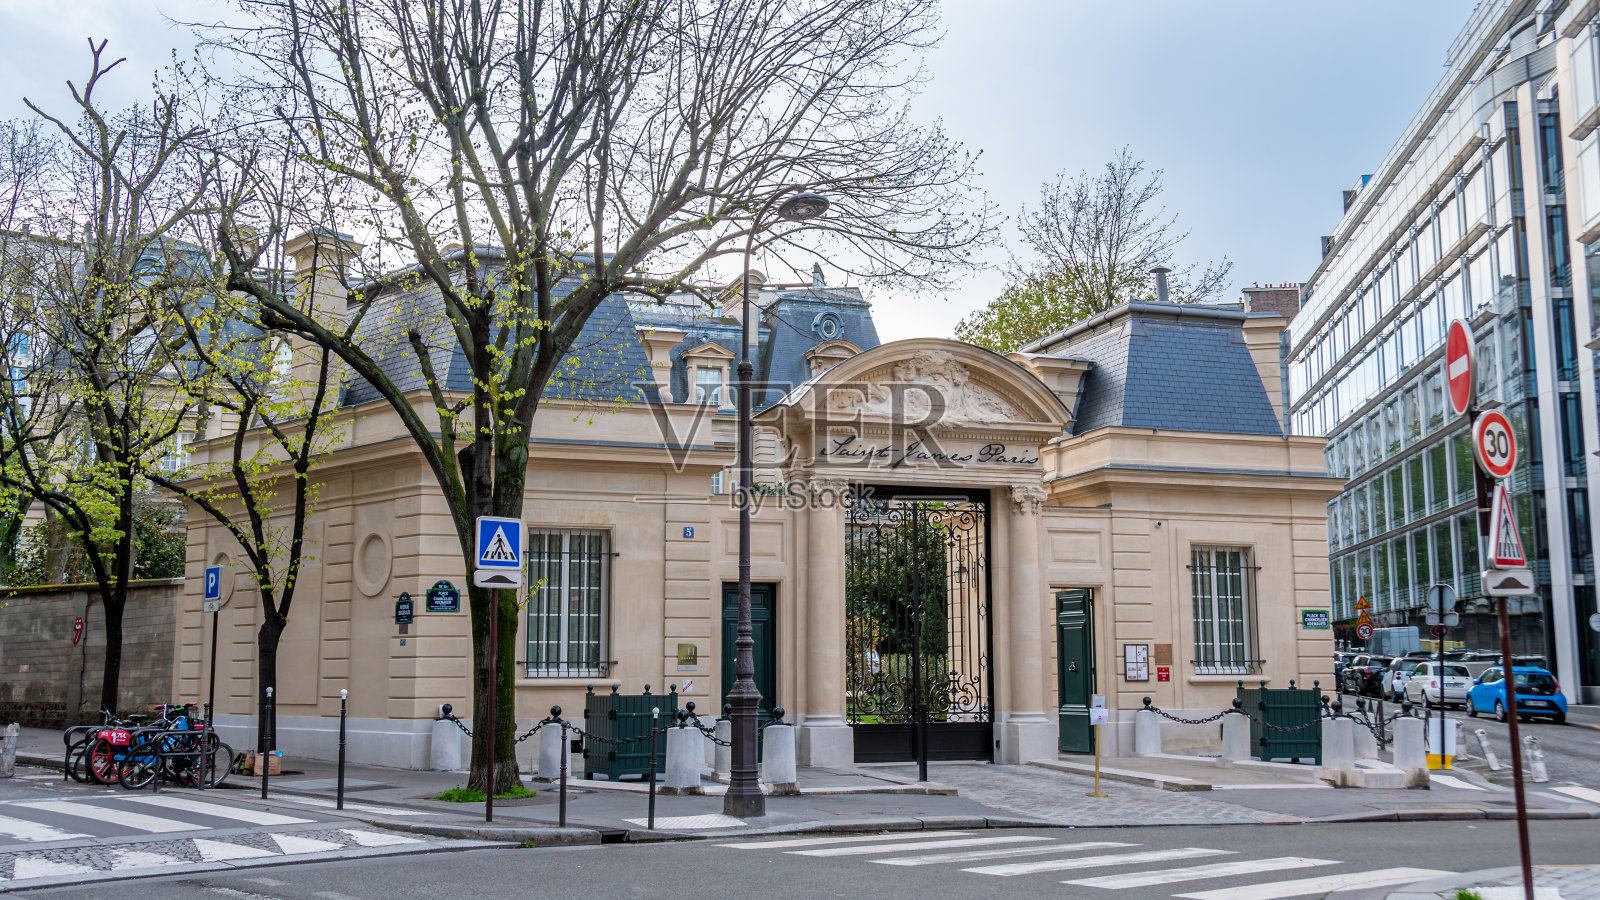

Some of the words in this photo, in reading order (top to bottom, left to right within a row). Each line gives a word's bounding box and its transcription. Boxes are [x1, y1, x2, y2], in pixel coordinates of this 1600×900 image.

[820, 435, 899, 457] Saint
[892, 439, 972, 468] James
[978, 443, 1039, 465] Paris
[1486, 430, 1508, 458] 30
[208, 572, 216, 594] P
